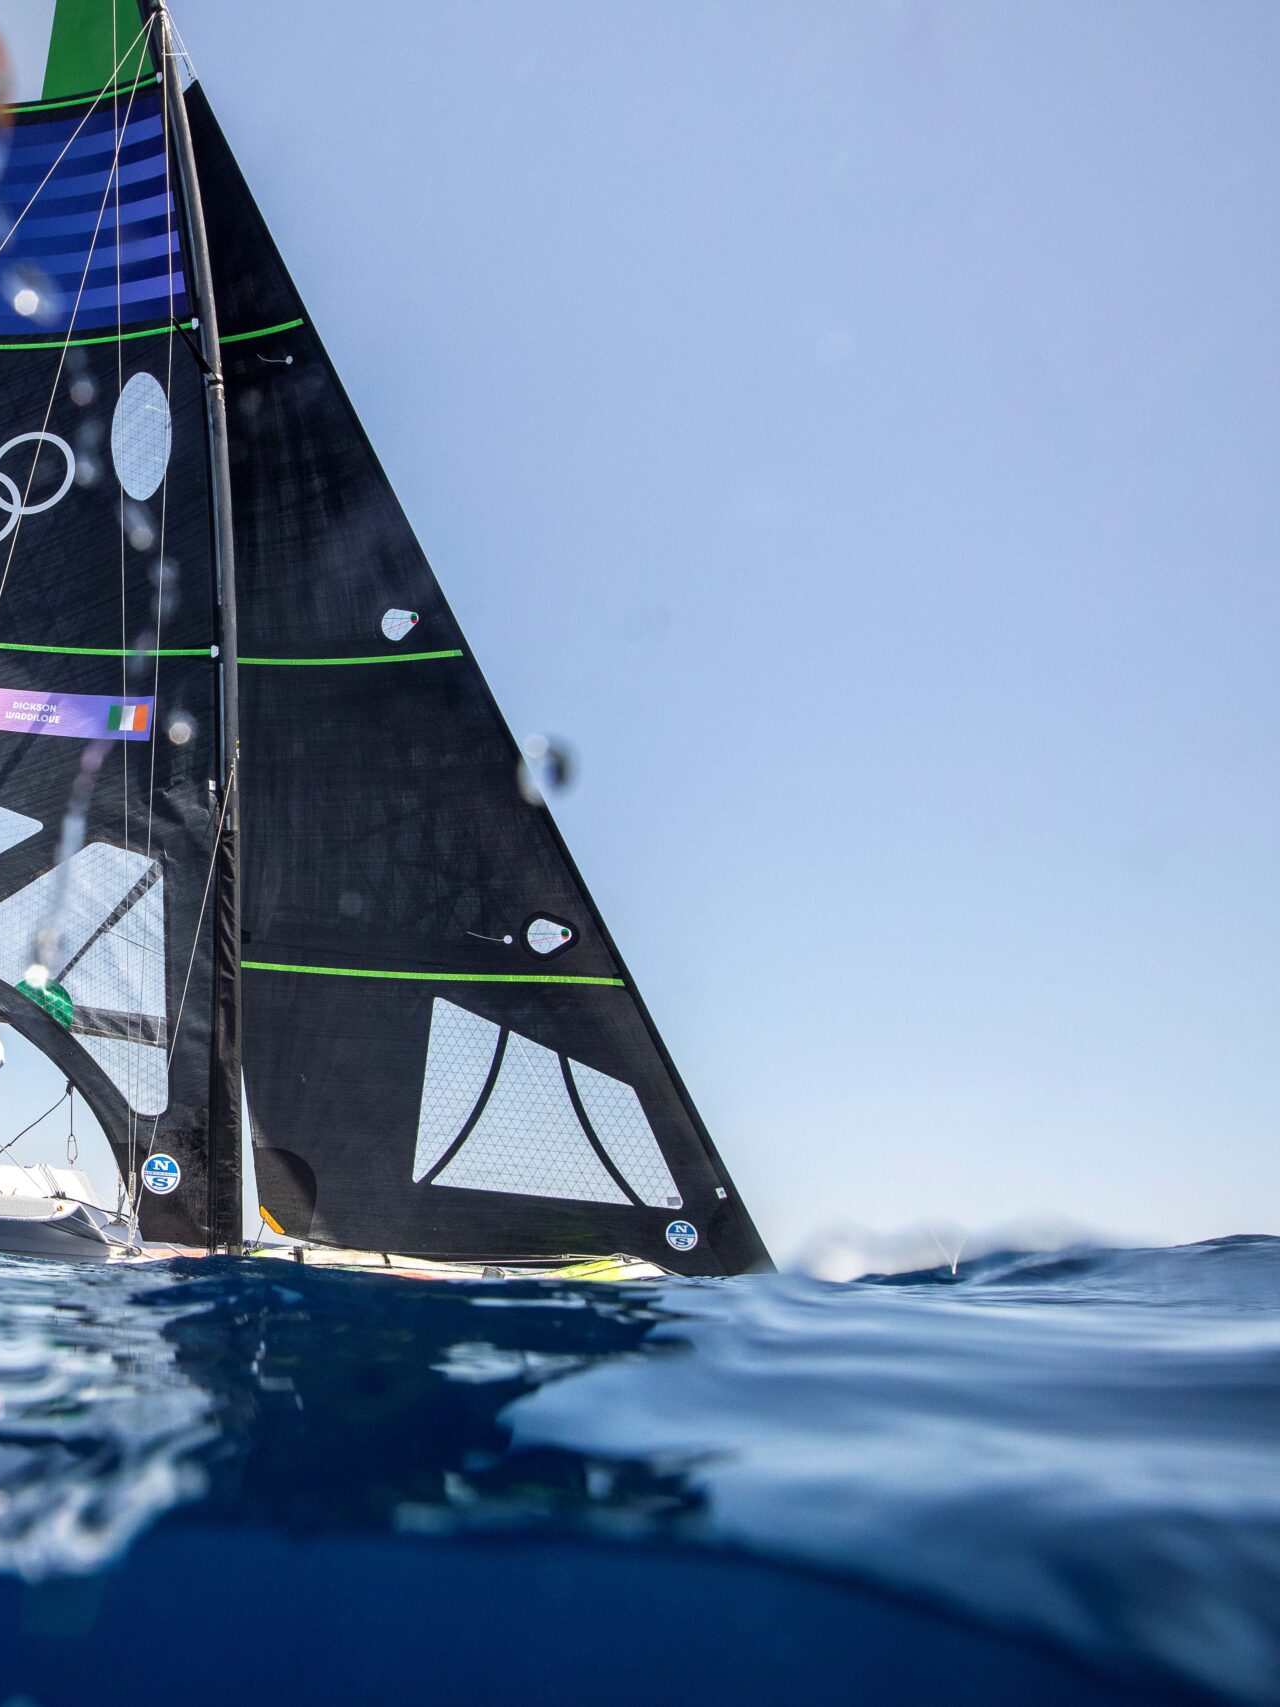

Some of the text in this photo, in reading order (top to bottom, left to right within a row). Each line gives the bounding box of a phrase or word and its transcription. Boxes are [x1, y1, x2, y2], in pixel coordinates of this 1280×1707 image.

[12, 701, 57, 712] DICKSON
[4, 711, 61, 724] WADDILOVE
[152, 1159, 171, 1171] N
[151, 1177, 169, 1188] S
[674, 1224, 689, 1233] N
[675, 1237, 689, 1246] S
